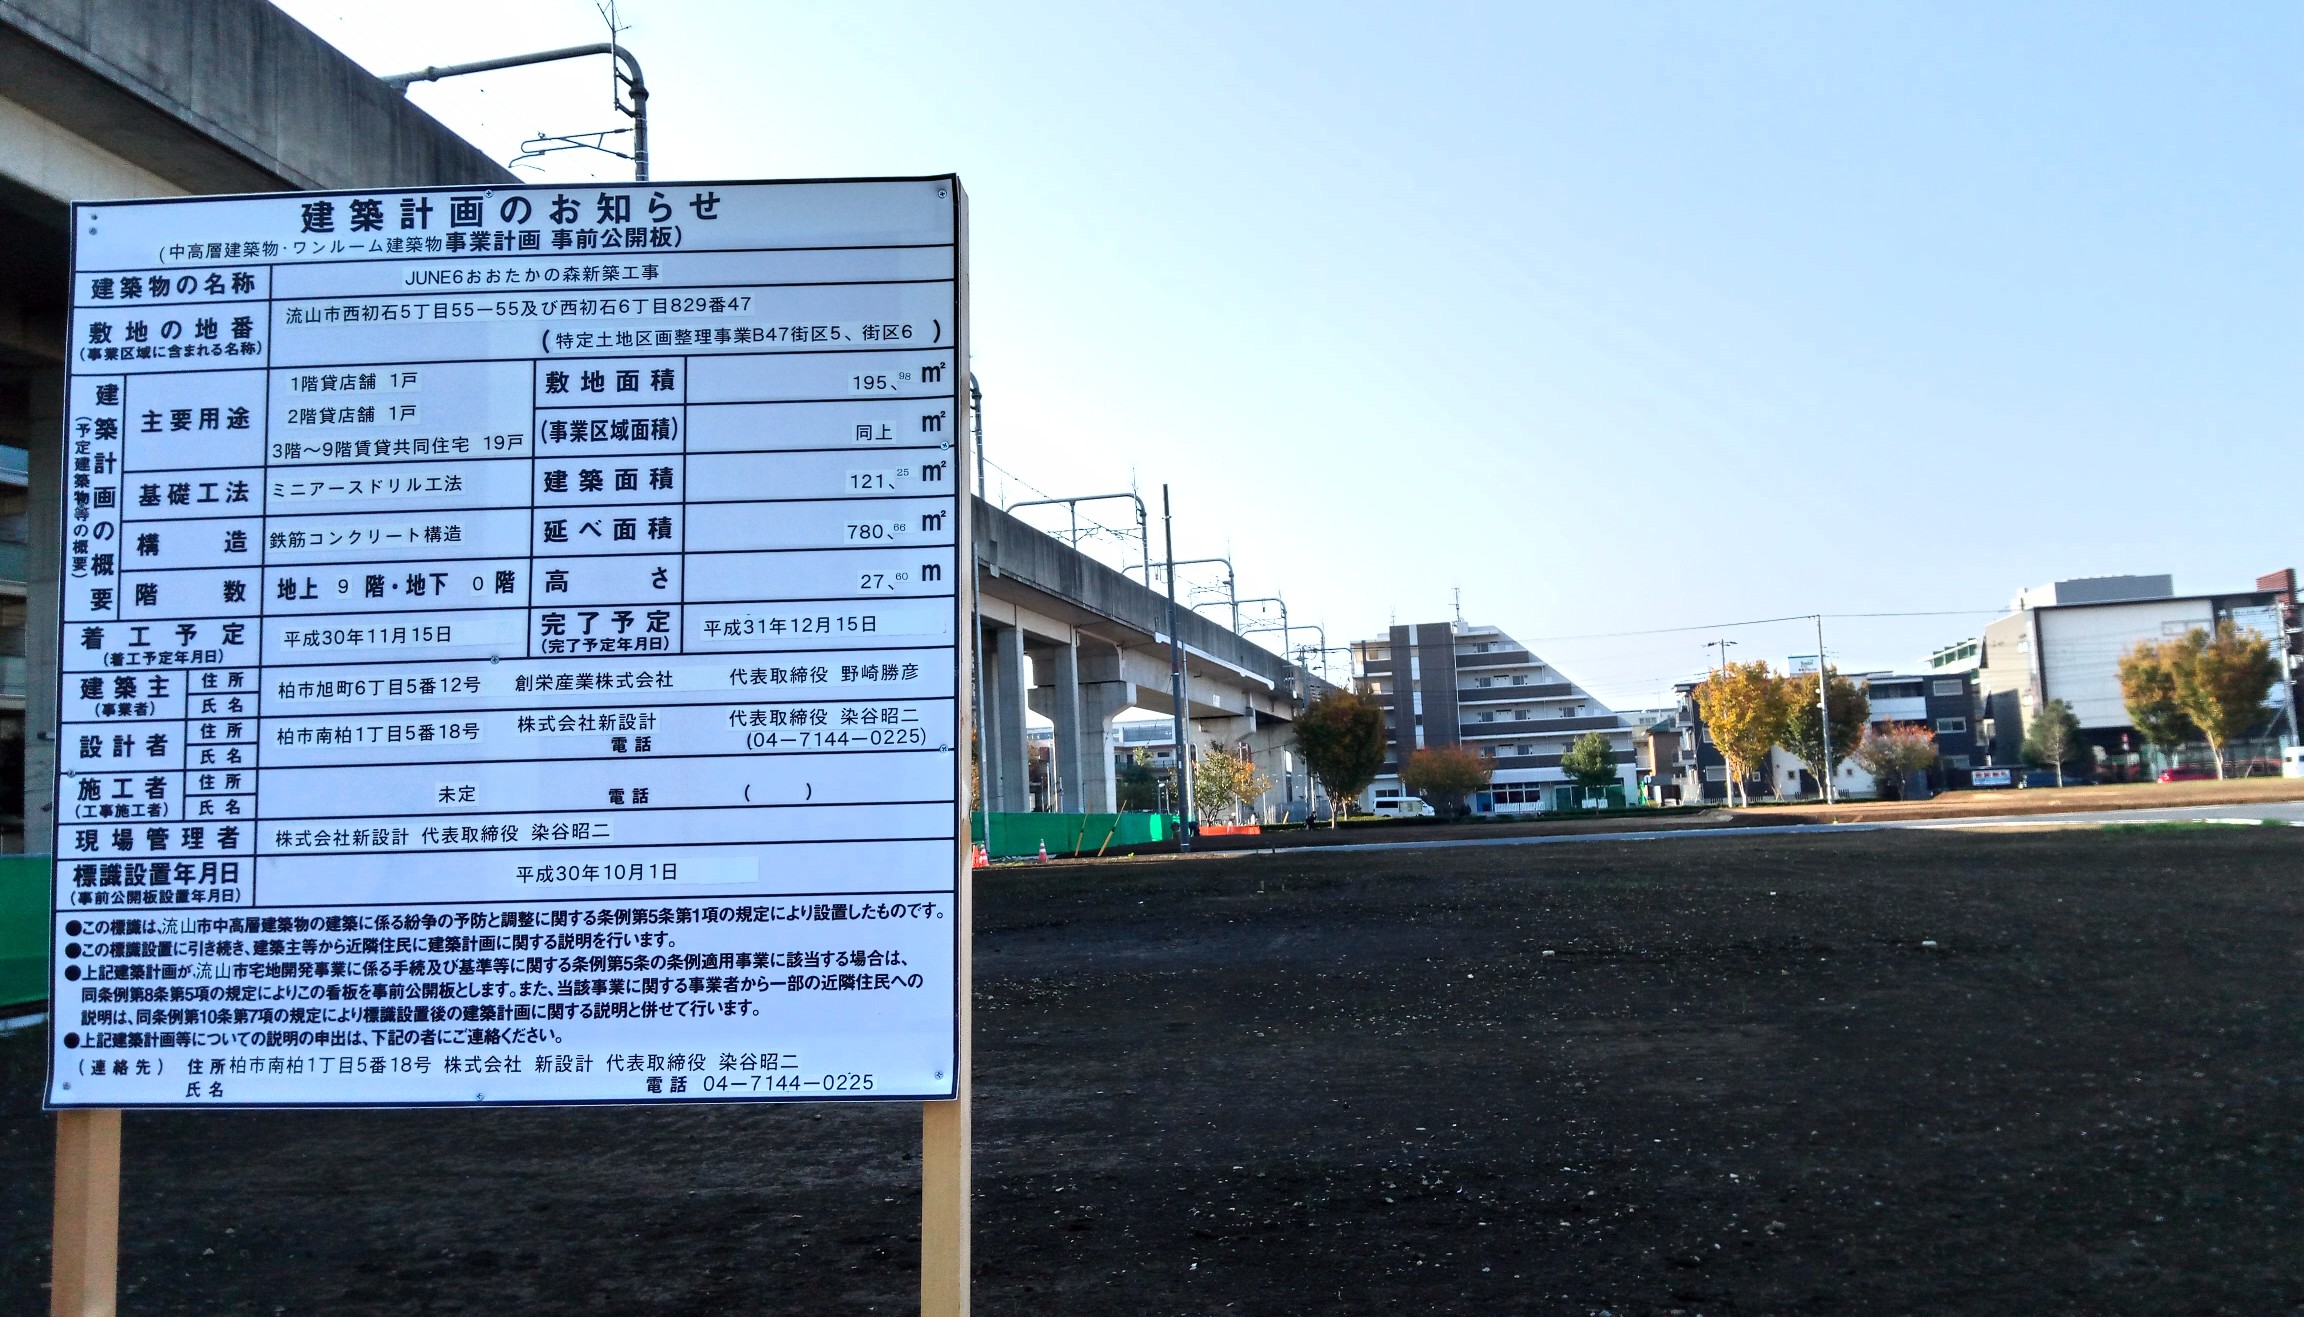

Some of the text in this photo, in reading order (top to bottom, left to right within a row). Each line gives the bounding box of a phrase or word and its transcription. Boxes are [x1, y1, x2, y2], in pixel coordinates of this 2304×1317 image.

[301, 191, 721, 234] 建築計画のお知らせ
[91, 271, 256, 301] 建築物の名称
[405, 263, 659, 287] JUNE6おおたかの森新築工事
[88, 315, 254, 345] 敷地の地番
[80, 341, 263, 362] (事業区域に含まれる名称)
[291, 372, 418, 394] 1階貸店舗 1戸
[545, 367, 675, 395] 敷地面積
[140, 407, 251, 433] 主要用途
[288, 405, 417, 426] 2階貸店舗 1戸
[484, 433, 524, 452] 19戸
[540, 417, 679, 445] (事業区域面積)
[856, 423, 892, 441] 同上
[272, 474, 463, 499] ミニアースドリル工法
[544, 465, 674, 493] 建築面積
[90, 383, 119, 611] 建築計画の概要
[139, 480, 250, 508] 基礎工法
[269, 525, 463, 550] 鉄筋コンクリート構造
[543, 515, 672, 543] 延べ面積
[337, 578, 349, 595] 9
[540, 609, 671, 636] 完了予定
[704, 615, 877, 637] 平成31年12月15日
[80, 622, 245, 650] 着工予定
[283, 625, 452, 649] 平成30年11月15日
[540, 634, 670, 655] (完了予定年月日)
[103, 647, 224, 668] (着工予定年月日)
[80, 673, 170, 701] 建築主
[201, 671, 244, 689] 住所
[277, 675, 481, 699] 柏市旭町6丁目5番12号
[515, 670, 674, 692] 創栄産業株式会社
[729, 667, 828, 687] 代表取締役
[94, 702, 156, 719] (事業者)
[201, 697, 244, 715] 氏名
[200, 722, 243, 740] 住所
[277, 706, 919, 746] 柏市南柏1丁目5番18号 株式会社新設計 代表取締役 染谷昭二
[80, 733, 168, 759] 設計者
[200, 747, 242, 765] 氏名
[611, 735, 652, 754] 電話
[77, 775, 167, 803] 施工者
[199, 772, 242, 790] 住所
[438, 784, 476, 803] 未定
[608, 786, 649, 805] 電話
[74, 802, 169, 819] (工事施工者)
[199, 798, 241, 816] 氏名
[75, 826, 240, 852] 現場管理者
[276, 822, 610, 848] 株式会社新設計 代表取締役 染谷昭二
[73, 861, 240, 888] 標識設置年月日
[515, 861, 678, 884] 平成30年10月1日
[69, 887, 242, 907] (事前公開板設置年月日)
[79, 1058, 163, 1076] (連絡先)
[444, 1054, 522, 1074] 株式会社
[535, 1054, 593, 1073] 新設計
[606, 1053, 706, 1073] 代表取締役
[719, 1052, 799, 1071] 染谷昭二
[186, 1081, 224, 1098] 氏名
[646, 1076, 688, 1094] 電話
